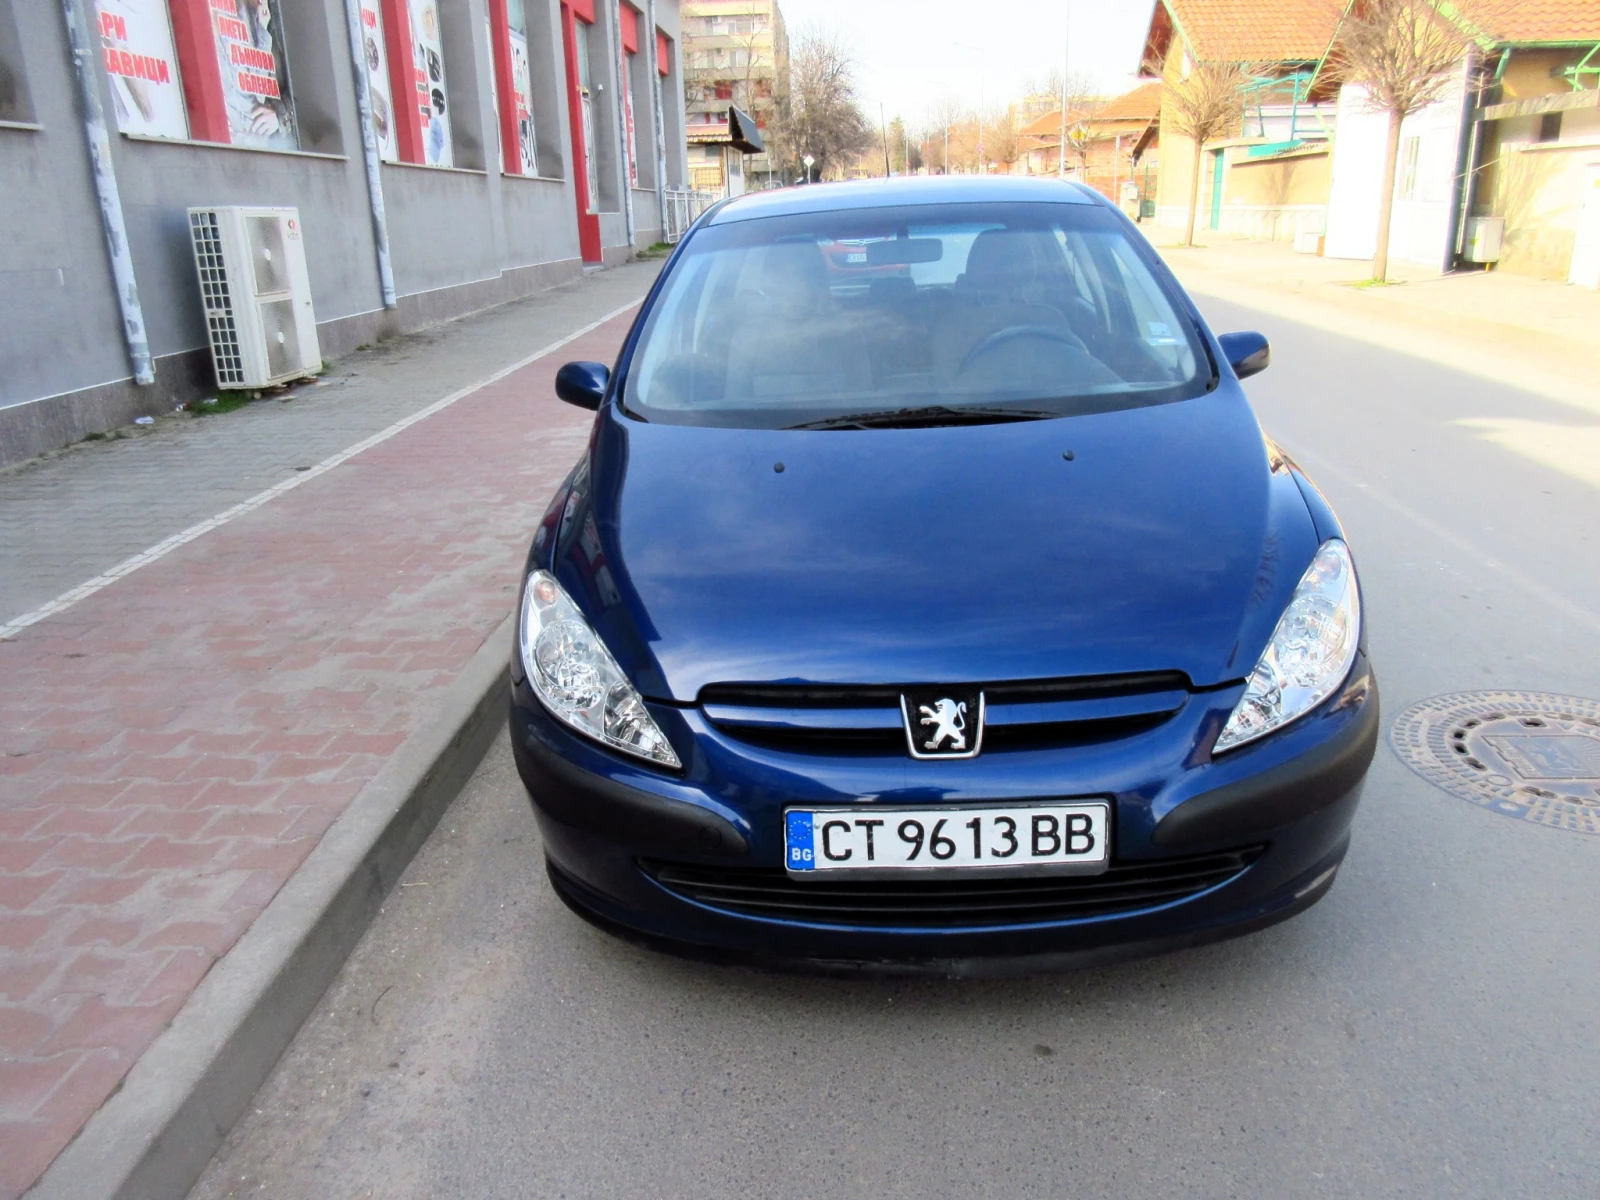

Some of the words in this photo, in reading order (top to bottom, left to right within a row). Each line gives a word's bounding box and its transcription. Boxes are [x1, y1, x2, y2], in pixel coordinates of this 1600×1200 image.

[218, 16, 250, 42] ЯКЕТА
[238, 72, 281, 98] ОБЛЕКЛА
[821, 819, 885, 862] CT
[897, 816, 1019, 861] 9613
[1030, 812, 1096, 857] BB
[791, 847, 813, 862] BG
